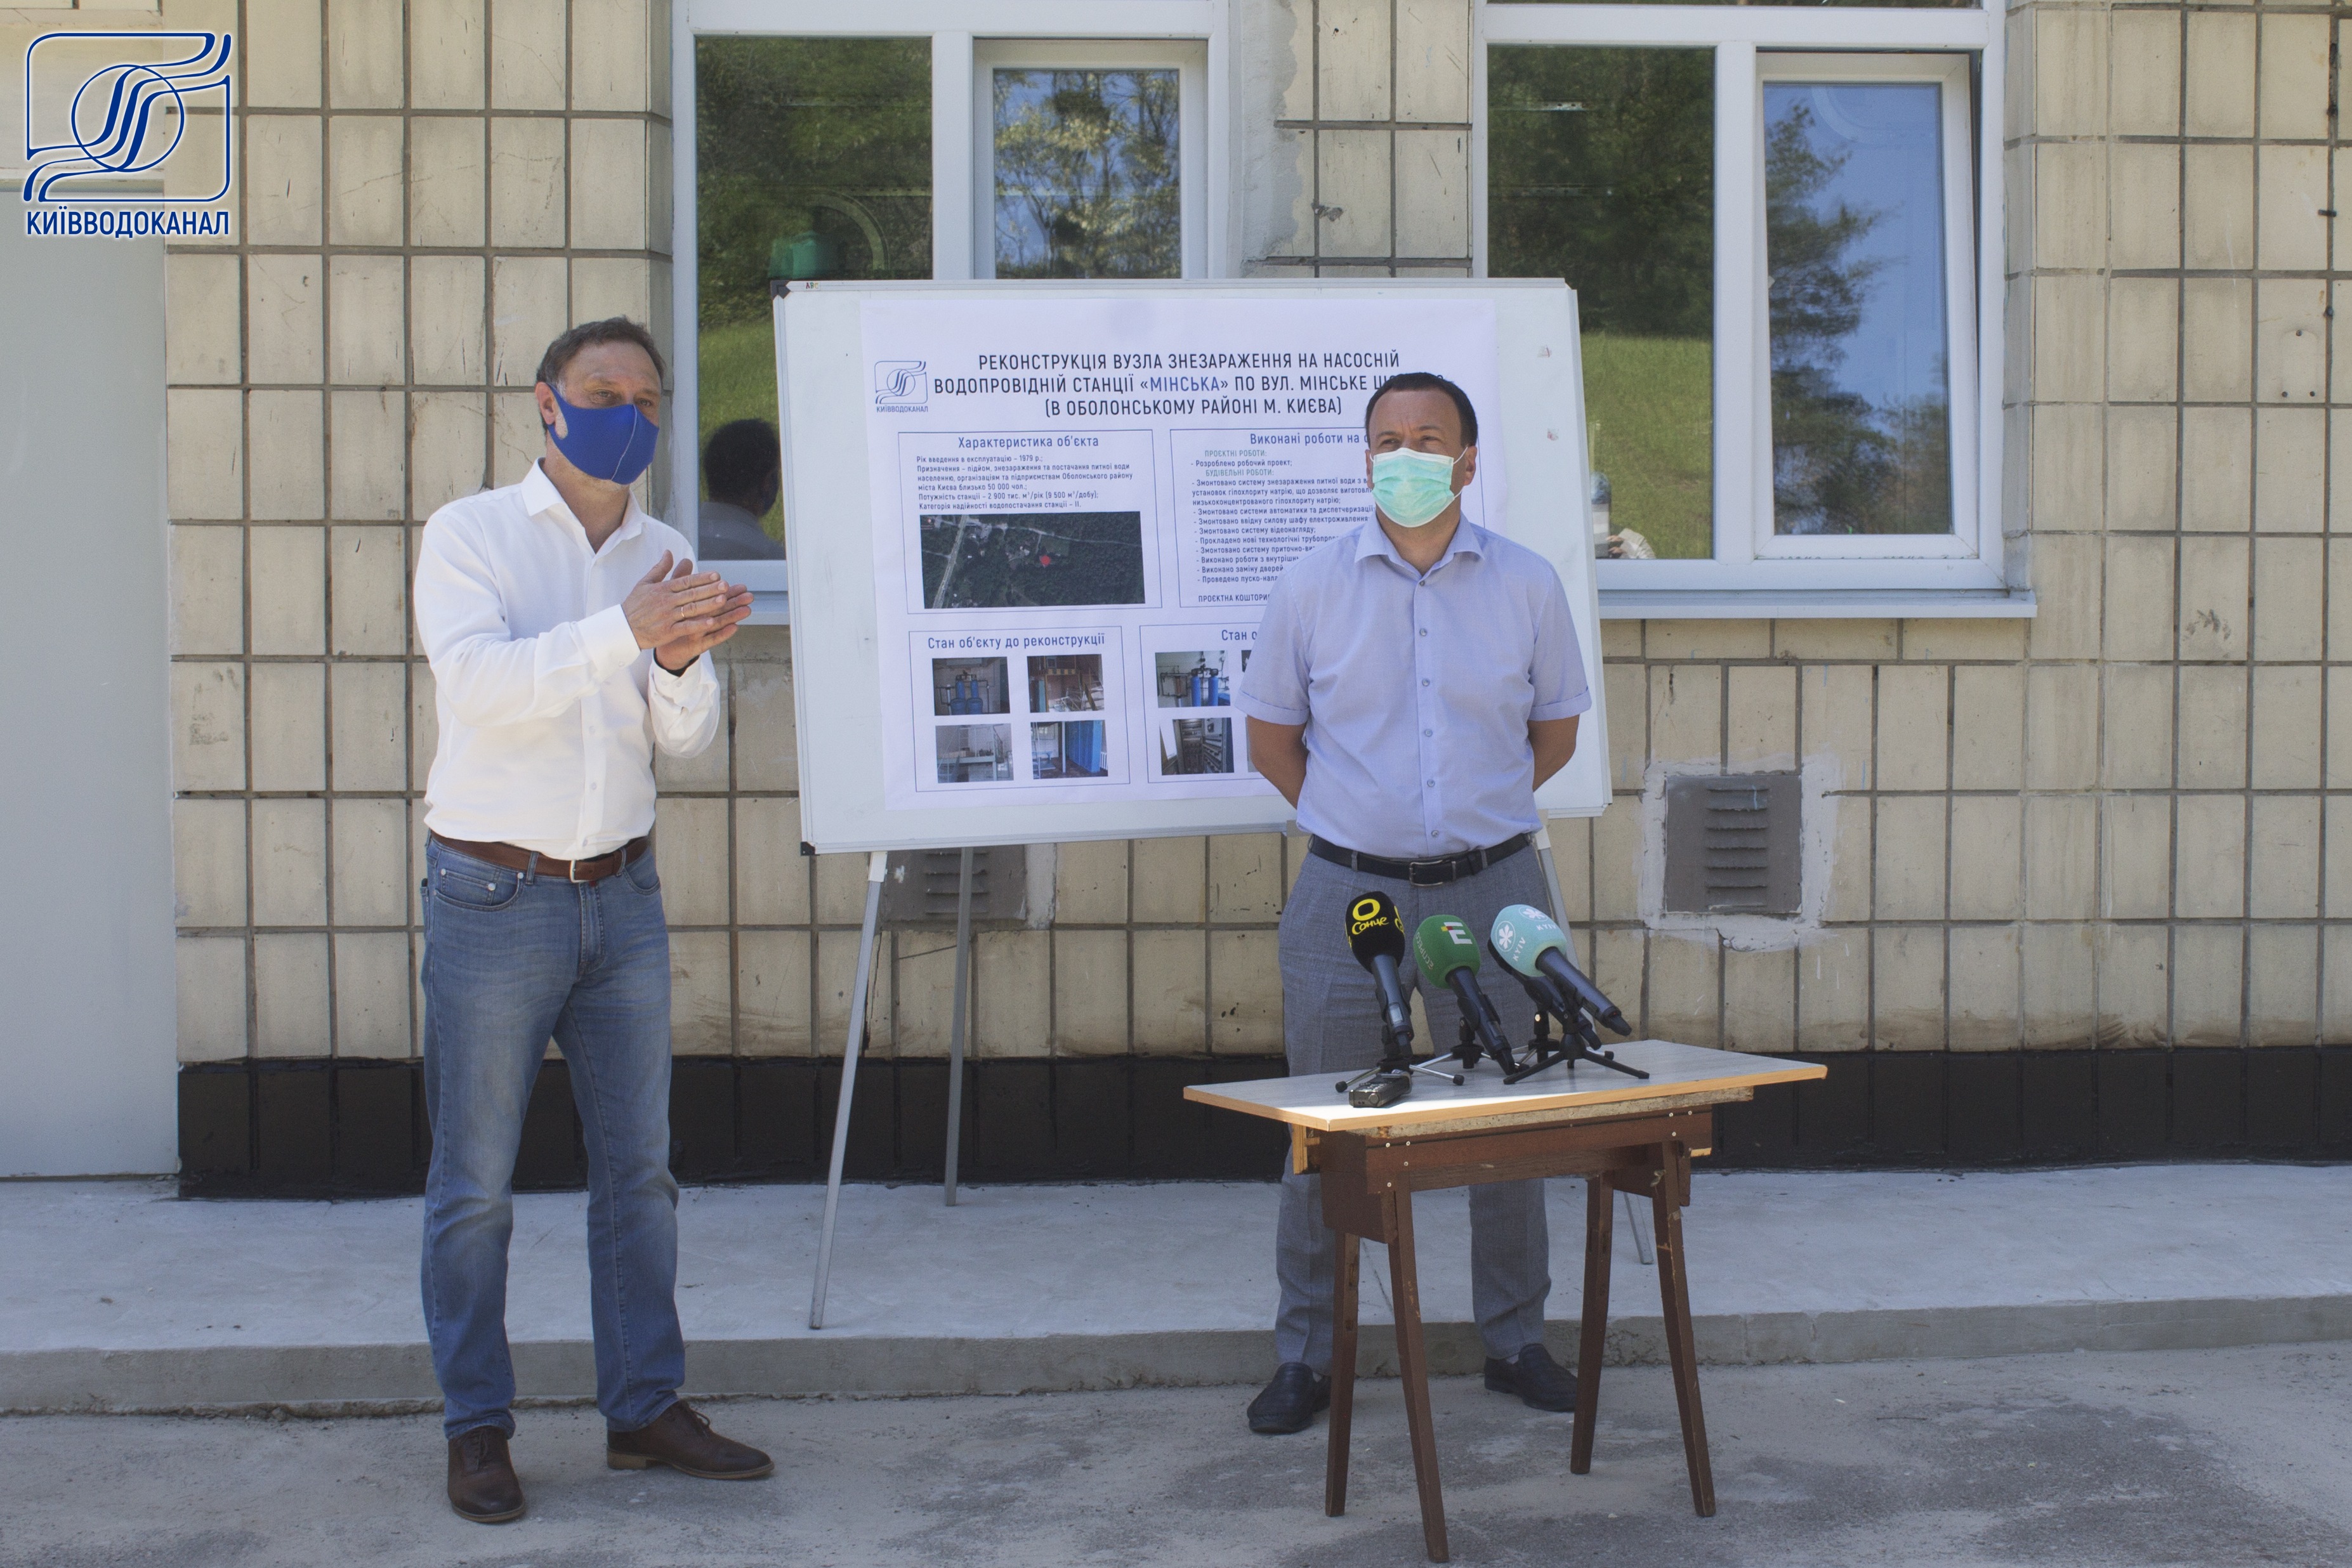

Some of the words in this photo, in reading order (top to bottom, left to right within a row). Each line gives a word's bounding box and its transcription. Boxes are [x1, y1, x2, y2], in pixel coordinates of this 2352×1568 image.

[979, 353, 1107, 371] РЕКОНСТРУКЦІЯ
[1114, 353, 1162, 369] ВУЗЛА
[1168, 353, 1292, 369] ЗНЕЗАРАЖЕННЯ
[1298, 353, 1318, 368] НА
[1324, 349, 1400, 368] НАСОСНІЙ
[934, 374, 1067, 396] ВОДОПРОВІДНІЙ
[1073, 376, 1134, 395] СТАНЦІЇ
[1140, 376, 1228, 392] «МІНСЬКА»
[1235, 376, 1255, 391] ПО
[1261, 376, 1294, 391] ВУЛ.
[1299, 375, 1367, 391] МІНСЬКЕ
[876, 405, 928, 414] КИЇВВОДОКАНАЛ
[1045, 399, 1060, 418] (В
[1067, 399, 1195, 416] ОБОЛОНСЬКОМУ
[1202, 395, 1258, 415] РАЙОНІ
[1264, 398, 1281, 414] М.
[1287, 396, 1342, 415] КИЄВА)
[958, 436, 1053, 450] Характеристика
[1057, 435, 1099, 447] об'єкта
[1250, 433, 1301, 445] Виконані
[1304, 433, 1343, 447] роботи
[1347, 434, 1360, 443] на
[967, 455, 1012, 464] експлуатацію
[1195, 459, 1235, 468] Розроблено
[1237, 459, 1265, 467] робочий
[957, 474, 1000, 483] організаціям
[1011, 473, 1060, 482] підприємствам
[1062, 472, 1108, 480] Оболонського
[1110, 471, 1133, 481] району
[1238, 478, 1265, 487] систему
[1267, 478, 1315, 487] знезараження
[1228, 488, 1268, 497] гіпохлориту
[919, 493, 956, 502] Потужність
[1192, 498, 1273, 507] низькоконцентрованого
[1275, 497, 1315, 505] гіпохлориту
[919, 502, 951, 511] Категорія
[952, 502, 987, 510] надійності
[1044, 500, 1067, 509] станції
[1318, 505, 1375, 514] диспетчеризації
[1240, 517, 1262, 525] ввідну
[1289, 516, 1308, 525] шафу
[1309, 516, 1370, 524] електроживлення
[1200, 537, 1241, 546] Прокладено
[1258, 535, 1300, 544] технологічні
[1242, 546, 1270, 554] систему
[1235, 556, 1259, 564] роботи
[1236, 565, 1258, 573] заміну
[1259, 565, 1284, 573] дверей
[1199, 594, 1233, 603] ПРОЄКТНА
[1221, 630, 1247, 641] Стан
[928, 637, 955, 649] Стан
[959, 636, 1001, 650] об'єкту
[1005, 637, 1019, 649] до
[1023, 632, 1105, 649] реконструкції
[1513, 937, 1526, 962] KYIV
